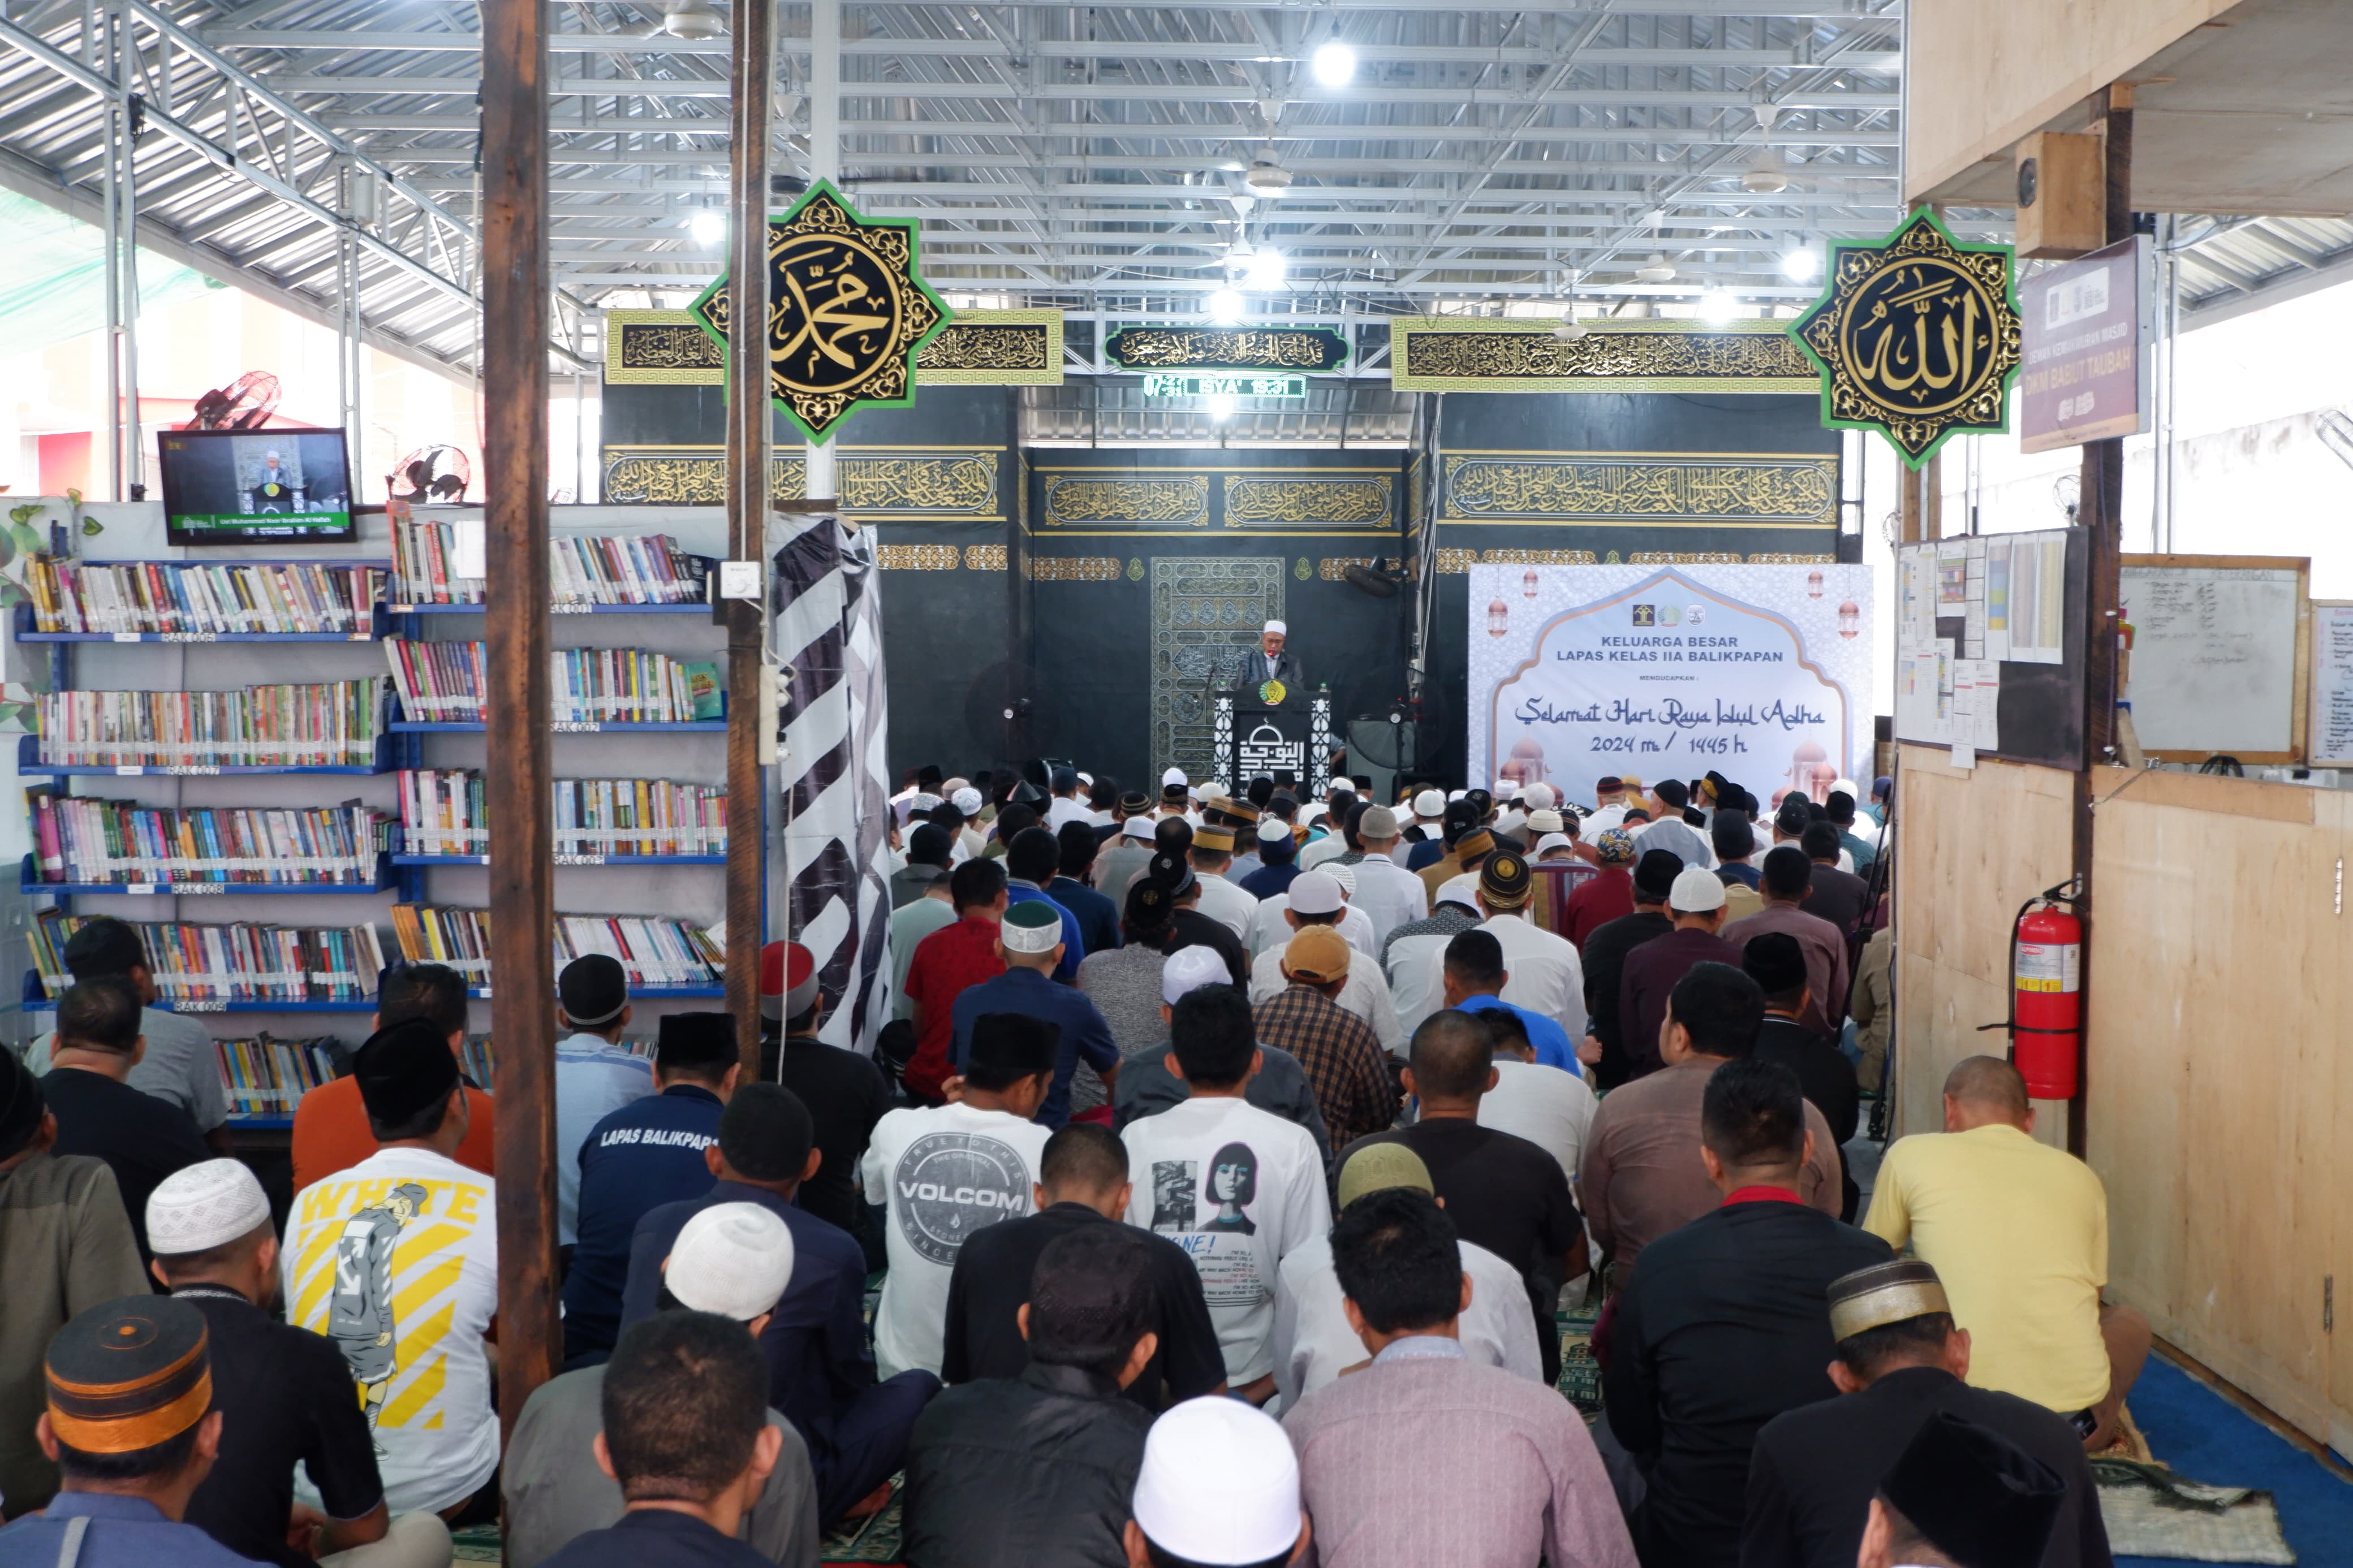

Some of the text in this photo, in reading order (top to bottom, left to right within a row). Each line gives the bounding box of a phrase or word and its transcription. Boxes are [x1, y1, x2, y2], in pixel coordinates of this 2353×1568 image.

[2102, 322, 2127, 342] MASJID
[2026, 348, 2131, 396] DKM BABUT TAUBAH
[1199, 379, 1243, 394] ISYA'
[550, 603, 566, 615] AK
[163, 633, 188, 642] RAK
[1601, 636, 1738, 647] KELUARGA BESAR
[1557, 651, 1783, 663] LAPAS KELAS IIA BALIKPAPAN
[1515, 696, 1826, 731] Selamat Hari Raya Idul Adha
[1590, 736, 1634, 753] 2024
[1689, 736, 1728, 754] 1445
[169, 765, 193, 775] RAK
[553, 855, 577, 865] RAK
[174, 884, 197, 894] RAK
[176, 1001, 200, 1011] RAK
[600, 1128, 719, 1151] LAPAS BALIKPAPA
[898, 1181, 1024, 1212] VOLCOM
[905, 1221, 955, 1260] SINCE
